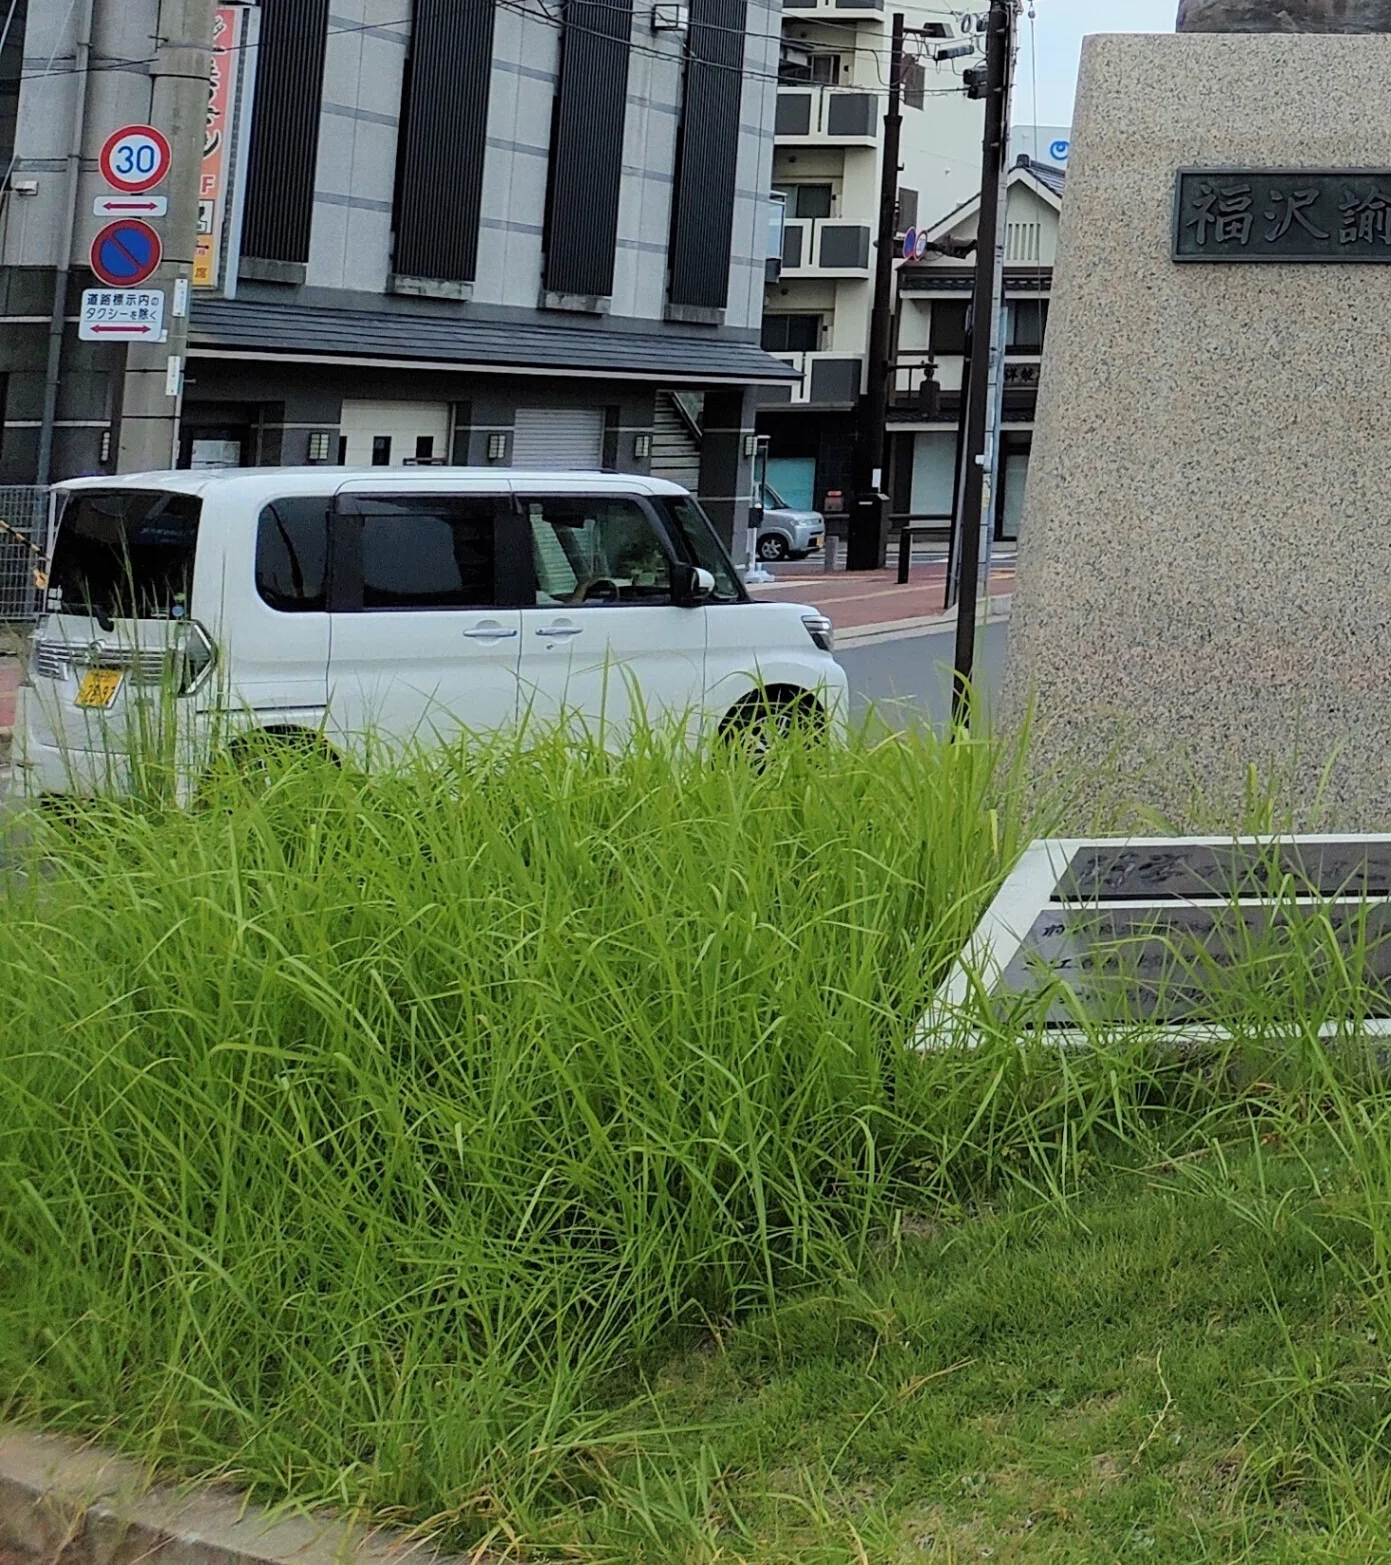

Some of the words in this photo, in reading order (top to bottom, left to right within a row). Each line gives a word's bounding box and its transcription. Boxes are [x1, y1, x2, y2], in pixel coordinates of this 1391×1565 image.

[116, 144, 155, 174] 30
[87, 292, 159, 307] 道路標示内の
[85, 307, 157, 321] タクシーを除く
